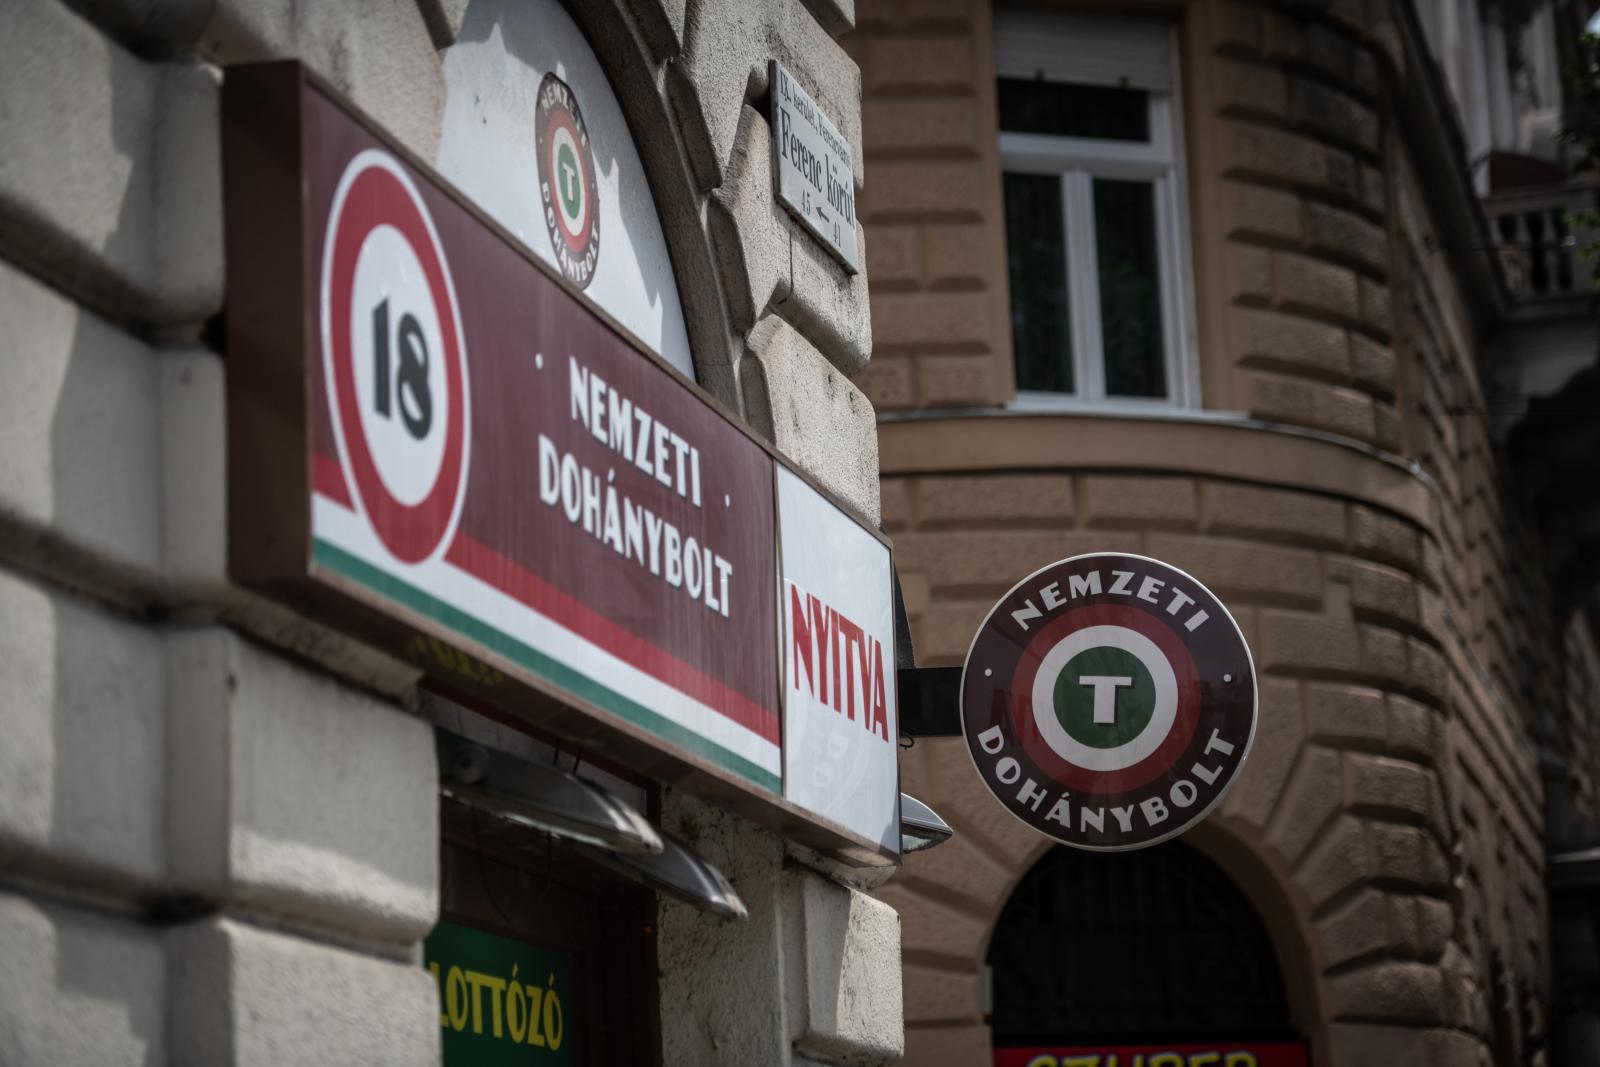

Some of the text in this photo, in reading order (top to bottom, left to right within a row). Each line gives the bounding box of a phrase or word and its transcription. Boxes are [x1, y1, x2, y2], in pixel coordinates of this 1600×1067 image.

[562, 161, 576, 202] T
[780, 106, 822, 192] Ferenc
[542, 181, 599, 282] DOHÁNYBOLT
[801, 188, 811, 216] 45
[372, 297, 433, 441] 18
[569, 355, 702, 508] NEMZETI
[538, 433, 733, 618] DOHÁNYBOLT
[1011, 570, 1210, 633] NEMZETI
[790, 583, 889, 744] NYITVA
[1079, 675, 1134, 725] T
[977, 725, 1236, 833] DOHÁNYBOLT
[429, 961, 563, 1051] LOTTÓZÓ
